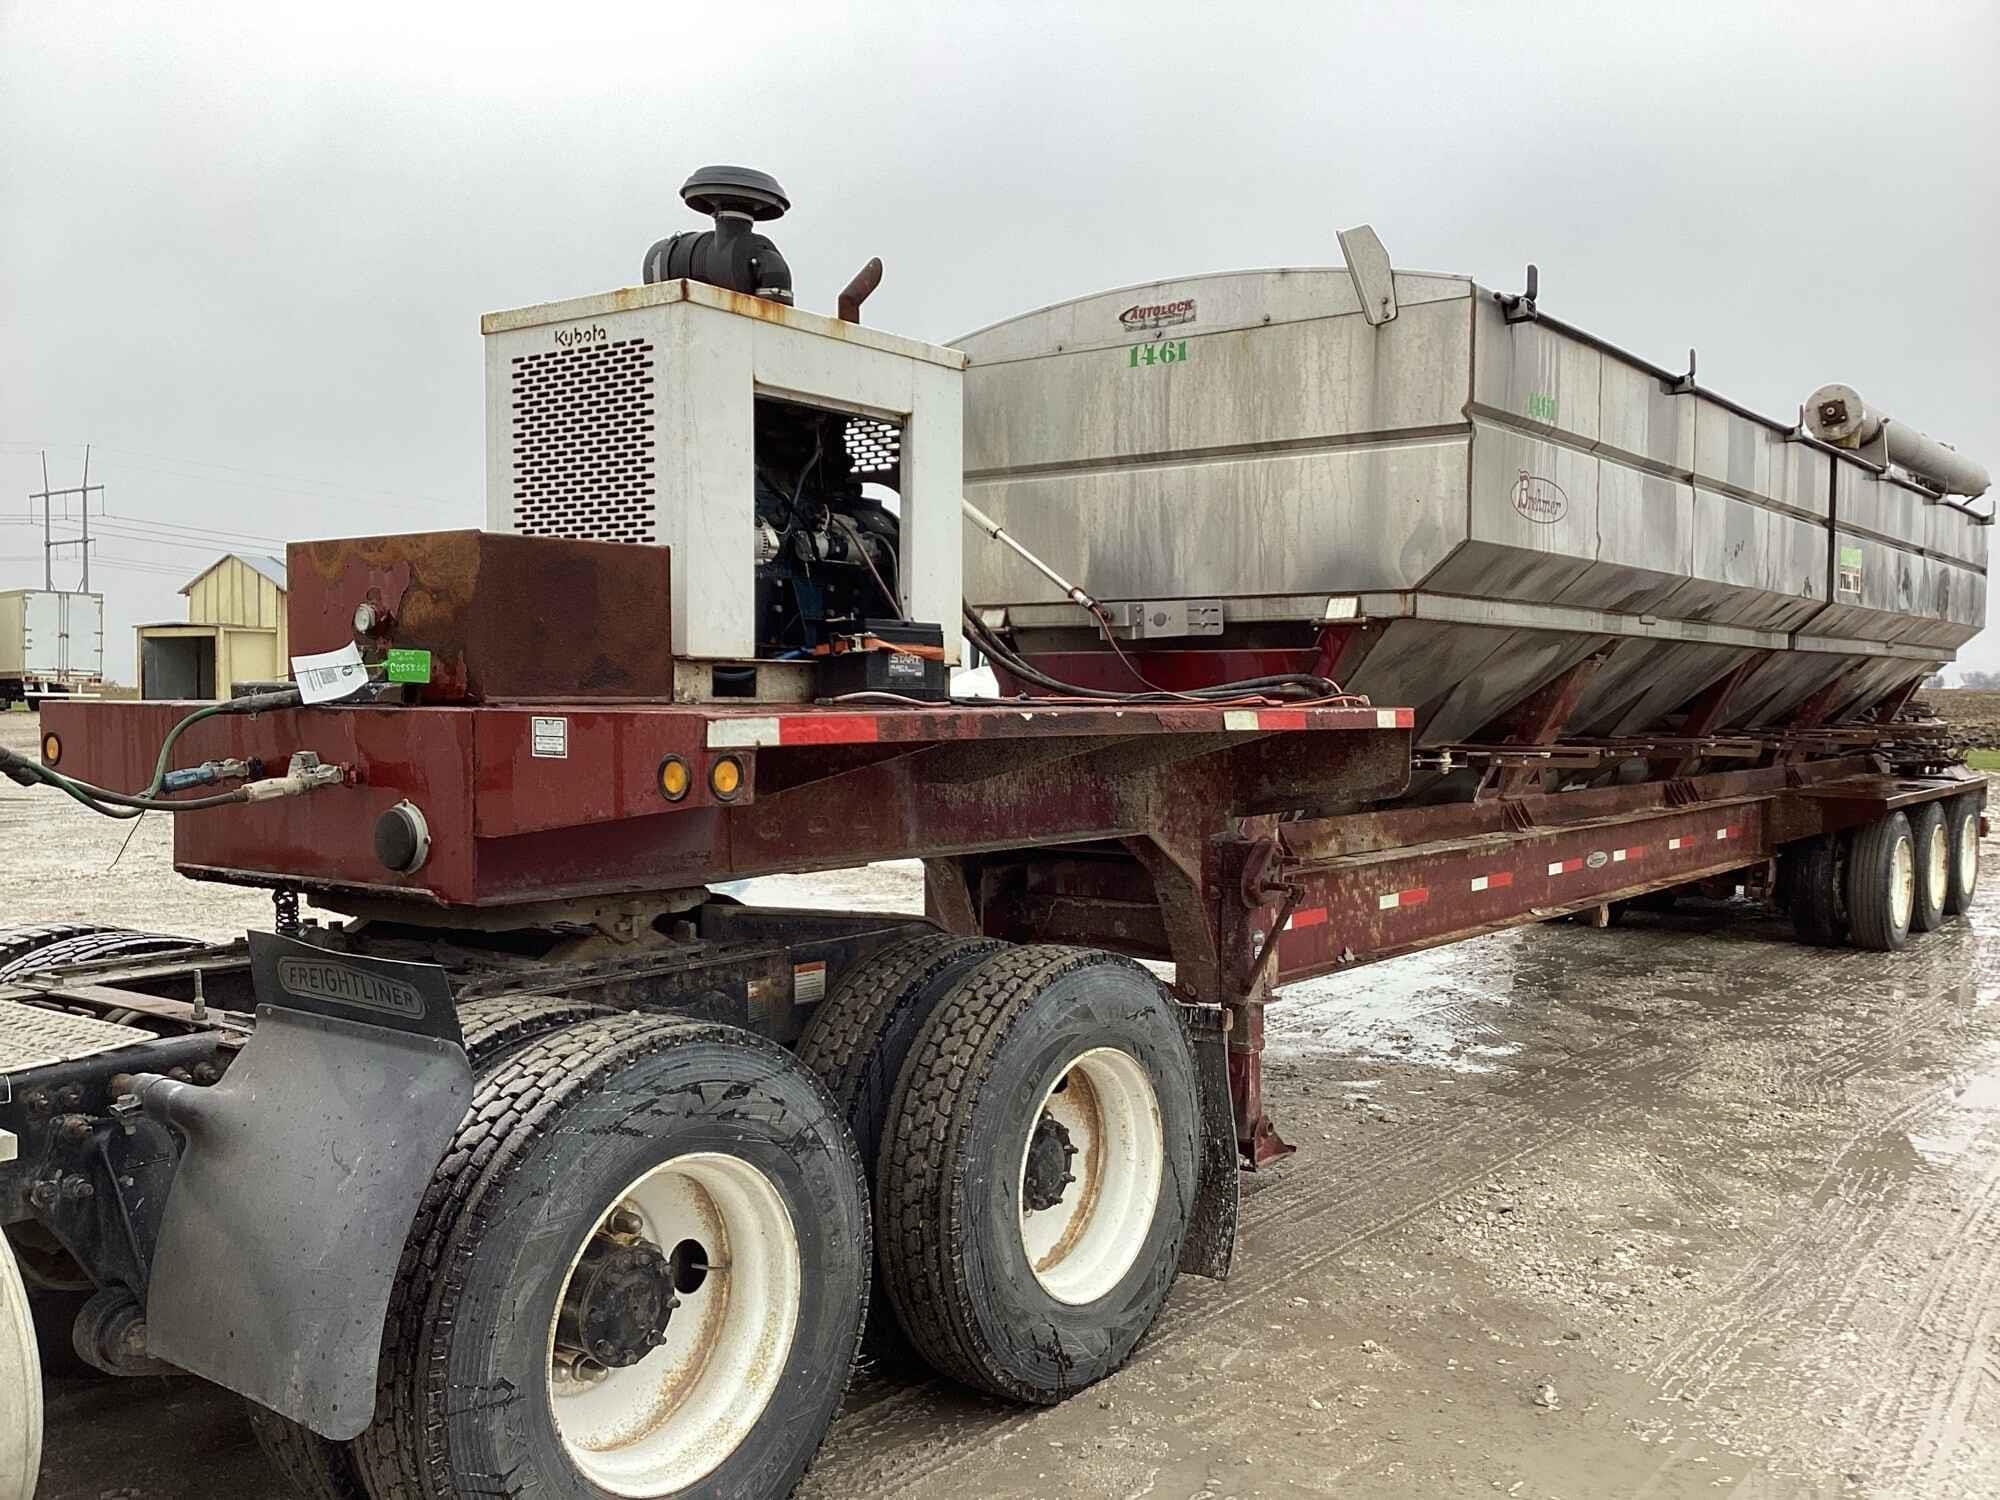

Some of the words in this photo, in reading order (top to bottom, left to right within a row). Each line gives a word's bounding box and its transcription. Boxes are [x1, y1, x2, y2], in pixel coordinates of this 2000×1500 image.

[1130, 299, 1194, 320] AUTOLOCK
[1129, 340, 1187, 367] 1461
[289, 966, 414, 1008] FREIGHTLINER
